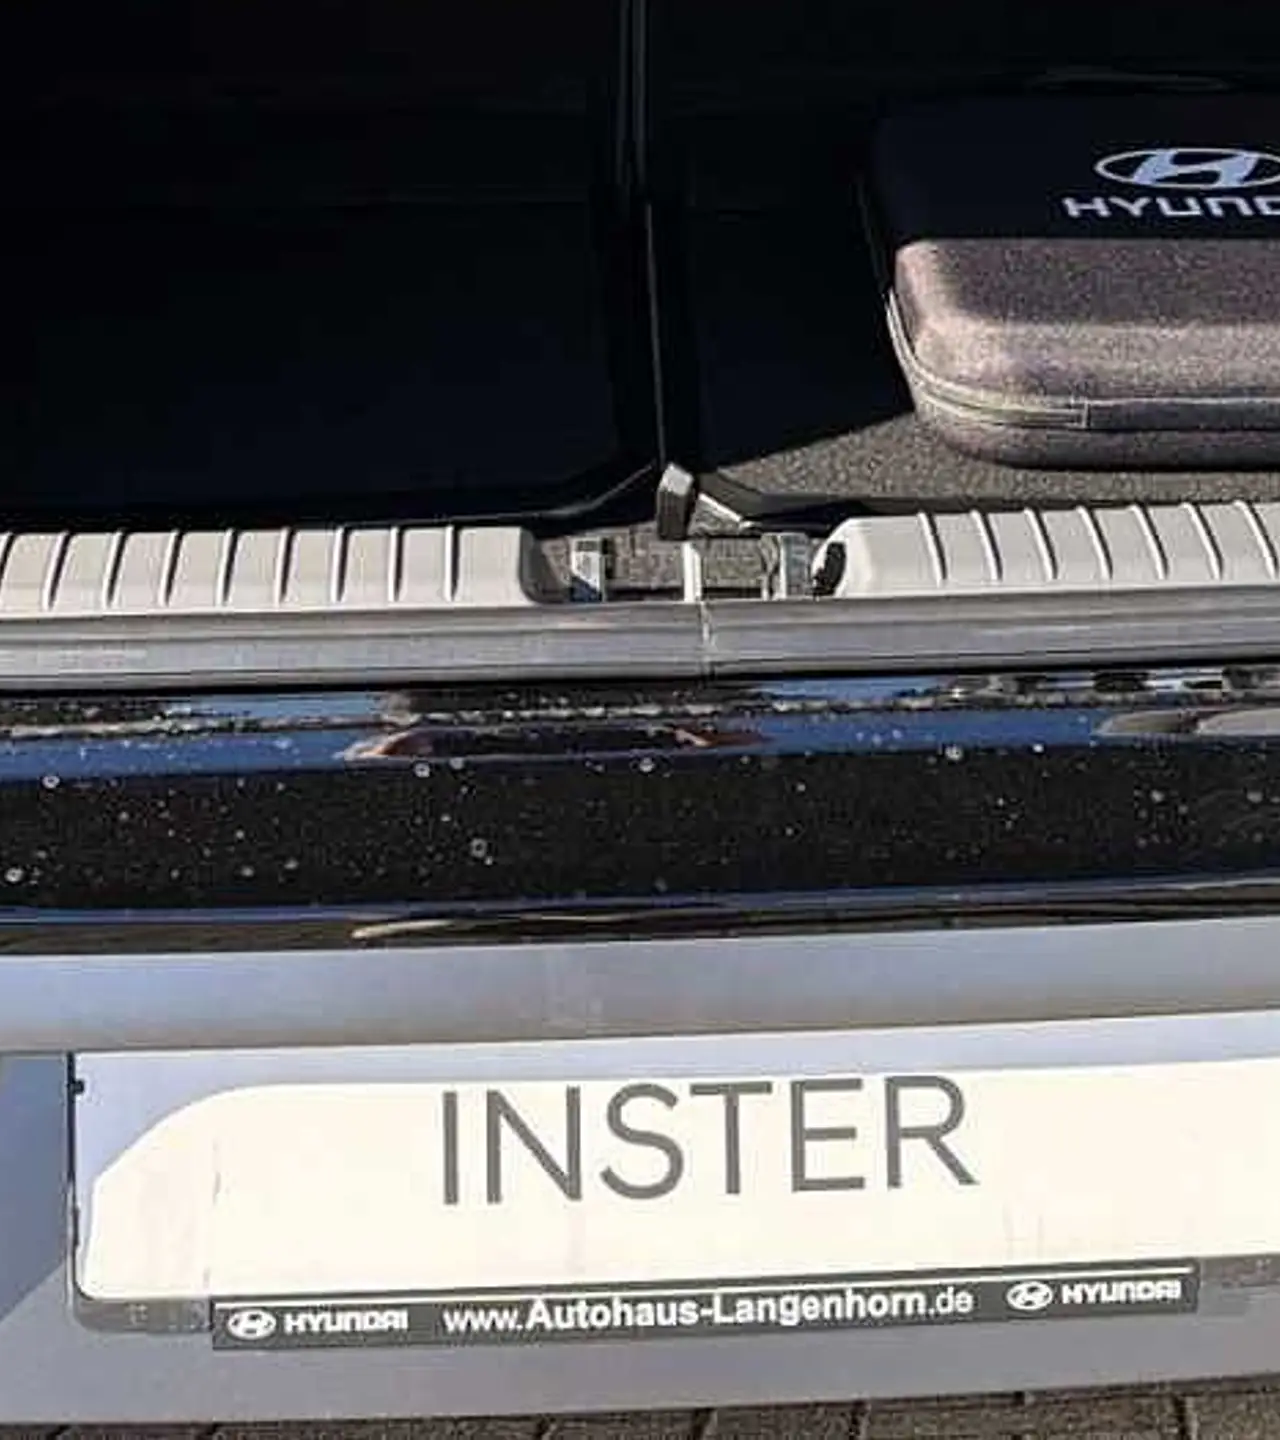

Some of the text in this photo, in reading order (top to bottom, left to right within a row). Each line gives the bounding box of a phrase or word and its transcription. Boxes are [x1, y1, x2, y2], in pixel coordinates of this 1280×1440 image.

[442, 1075, 980, 1205] INSTER
[283, 1279, 1182, 1333] HYUNDAI www.Autohaus-Langenhorn.de HYUNDAI
